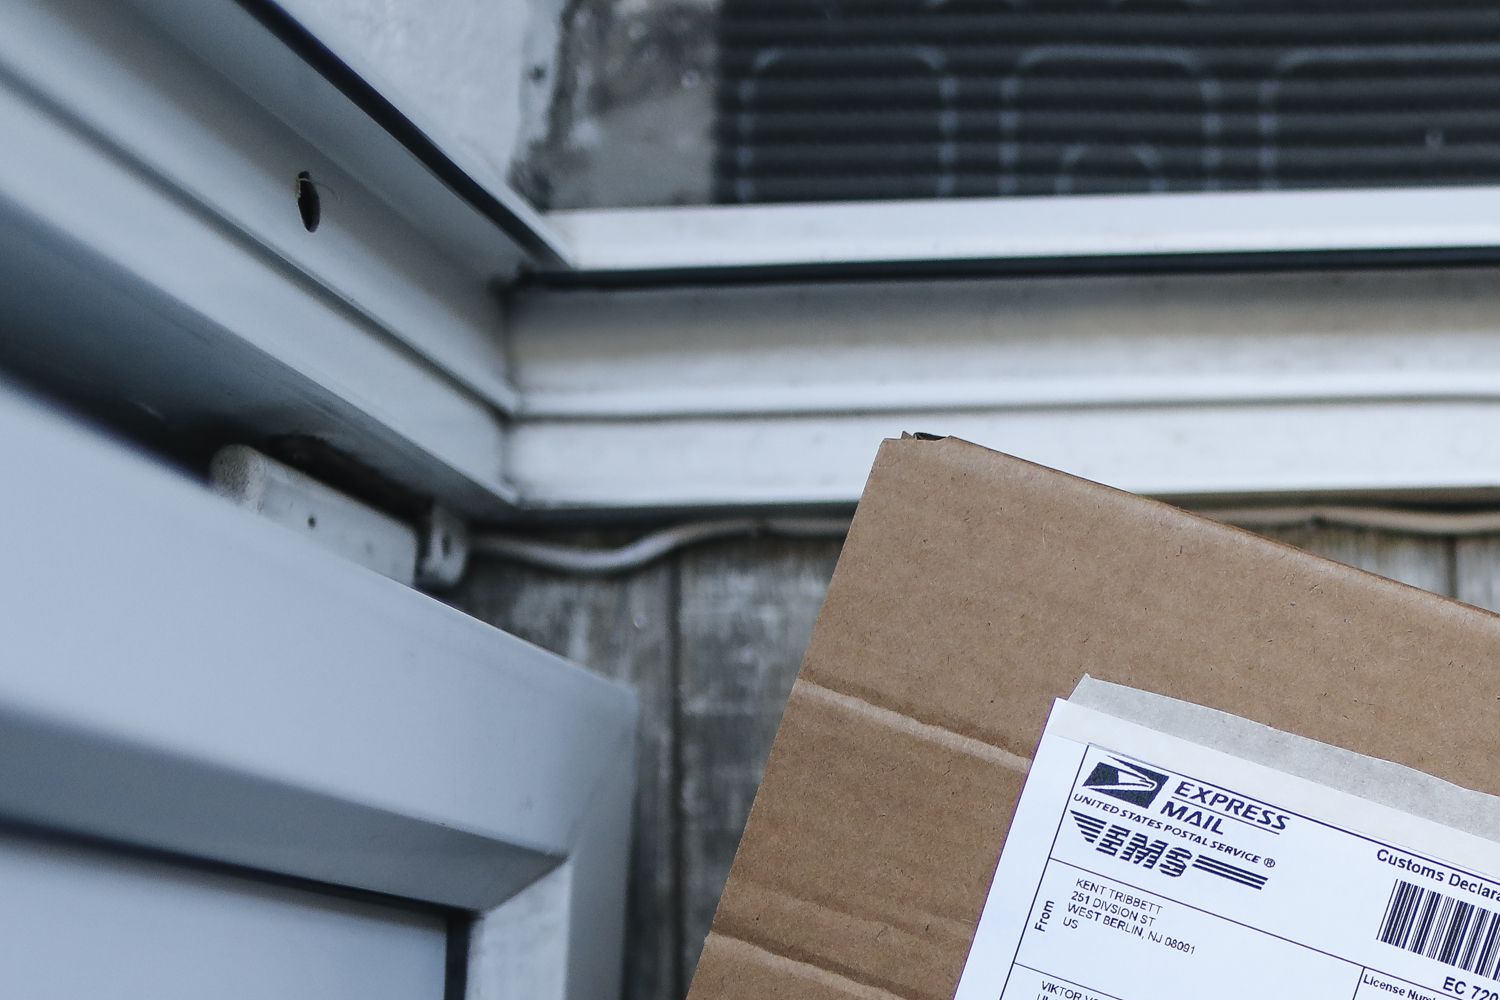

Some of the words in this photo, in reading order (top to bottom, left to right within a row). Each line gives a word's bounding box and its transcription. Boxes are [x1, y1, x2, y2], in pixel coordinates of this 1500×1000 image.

[1159, 800, 1224, 836] MAIL
[1173, 780, 1291, 831] EXPRESS
[1073, 793, 1120, 815] UNITED
[1119, 809, 1164, 830] STATES
[1163, 824, 1208, 847] POSTAL
[1209, 840, 1262, 864] SERVICE
[1095, 824, 1193, 878] EMS
[1376, 848, 1446, 882] Customs
[1070, 890, 1091, 905] 251
[1092, 897, 1139, 922] DIVSION
[1139, 914, 1157, 927] ST
[1075, 877, 1108, 896] KENT
[1108, 888, 1164, 915] TRIBBETT
[1033, 900, 1055, 933] From
[1062, 916, 1079, 930] US
[1067, 902, 1102, 922] WEST
[1102, 914, 1145, 940] BERLIN,
[1147, 930, 1164, 944] NJ
[1164, 936, 1196, 955] 08091
[1362, 973, 1406, 997] License
[1442, 975, 1467, 996] EC
